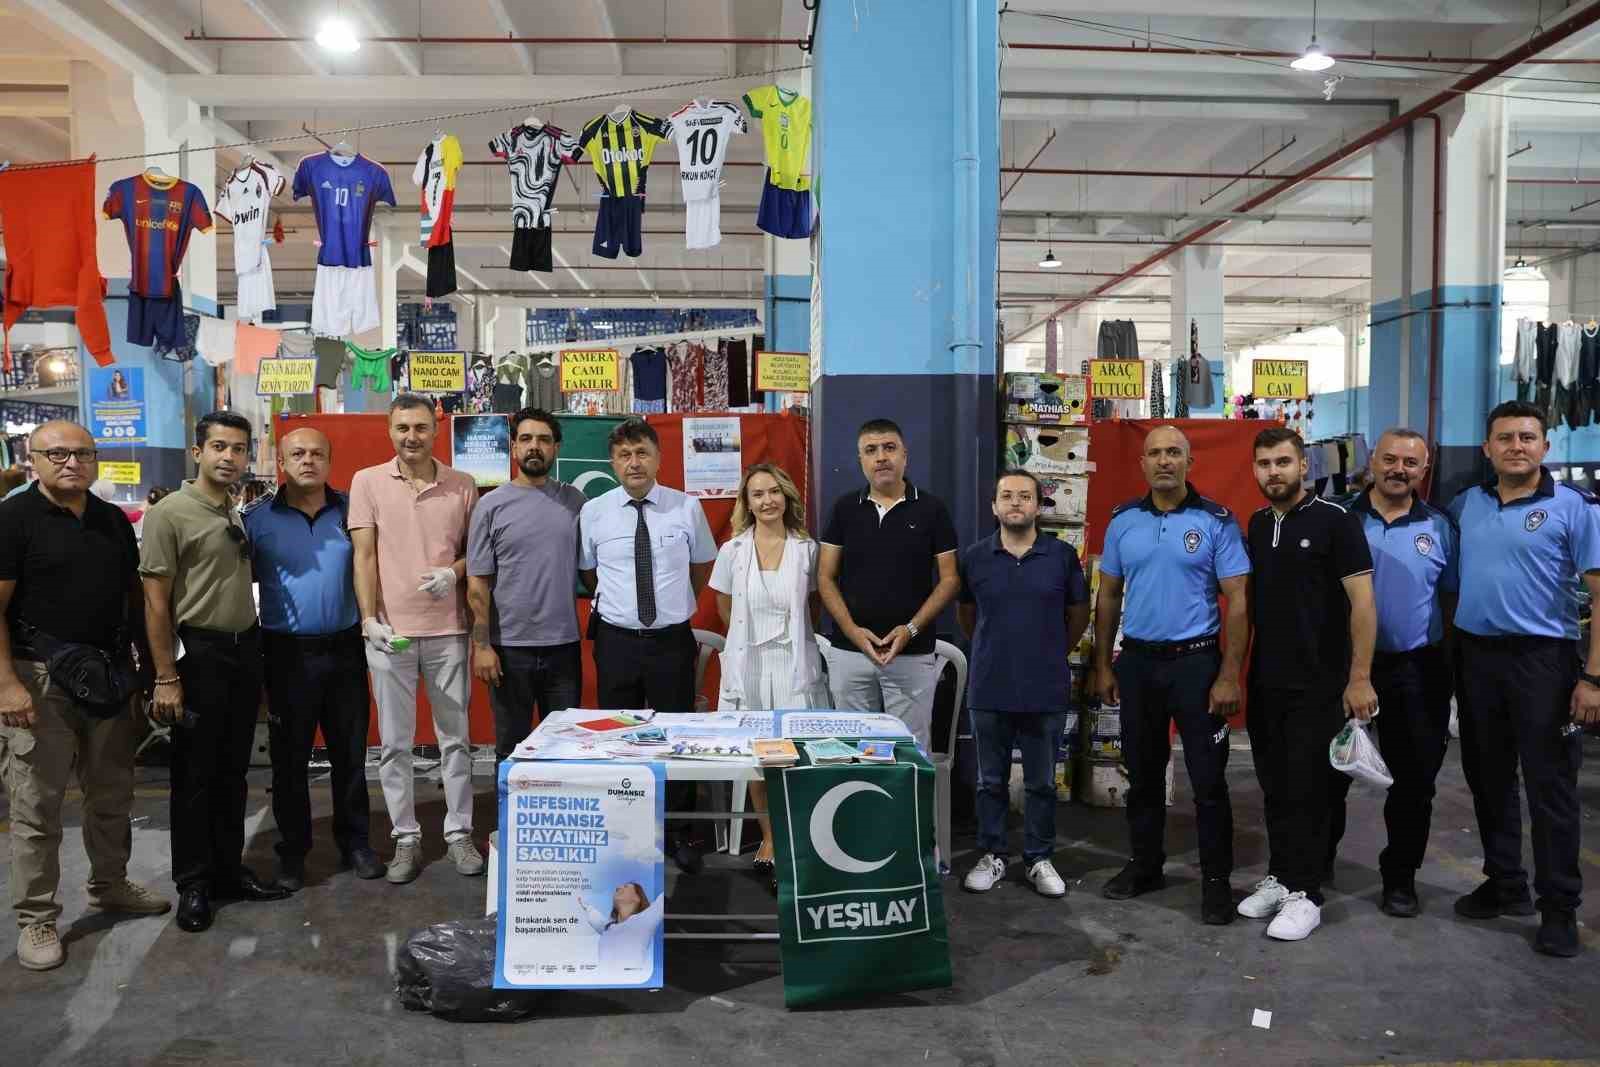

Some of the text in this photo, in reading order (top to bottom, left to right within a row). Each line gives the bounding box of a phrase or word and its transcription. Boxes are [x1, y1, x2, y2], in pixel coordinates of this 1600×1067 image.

[687, 128, 718, 166] 10
[336, 187, 348, 207] 10
[234, 205, 260, 225] bwin
[416, 356, 456, 364] KIRILMAZ
[562, 352, 614, 362] KAMERA
[413, 368, 438, 376] NANO
[1099, 363, 1133, 379] ARAÇ
[422, 380, 452, 388] TAKILIR
[564, 380, 612, 388] TAKILIR
[1267, 382, 1292, 396] CAM
[1030, 404, 1070, 414] MATHIAS
[516, 795, 600, 811] NEFESİNİZ
[517, 812, 605, 828] DUMANSIZ
[518, 829, 606, 845] HAYATINIZ
[806, 898, 917, 930] YEŞİLAY
